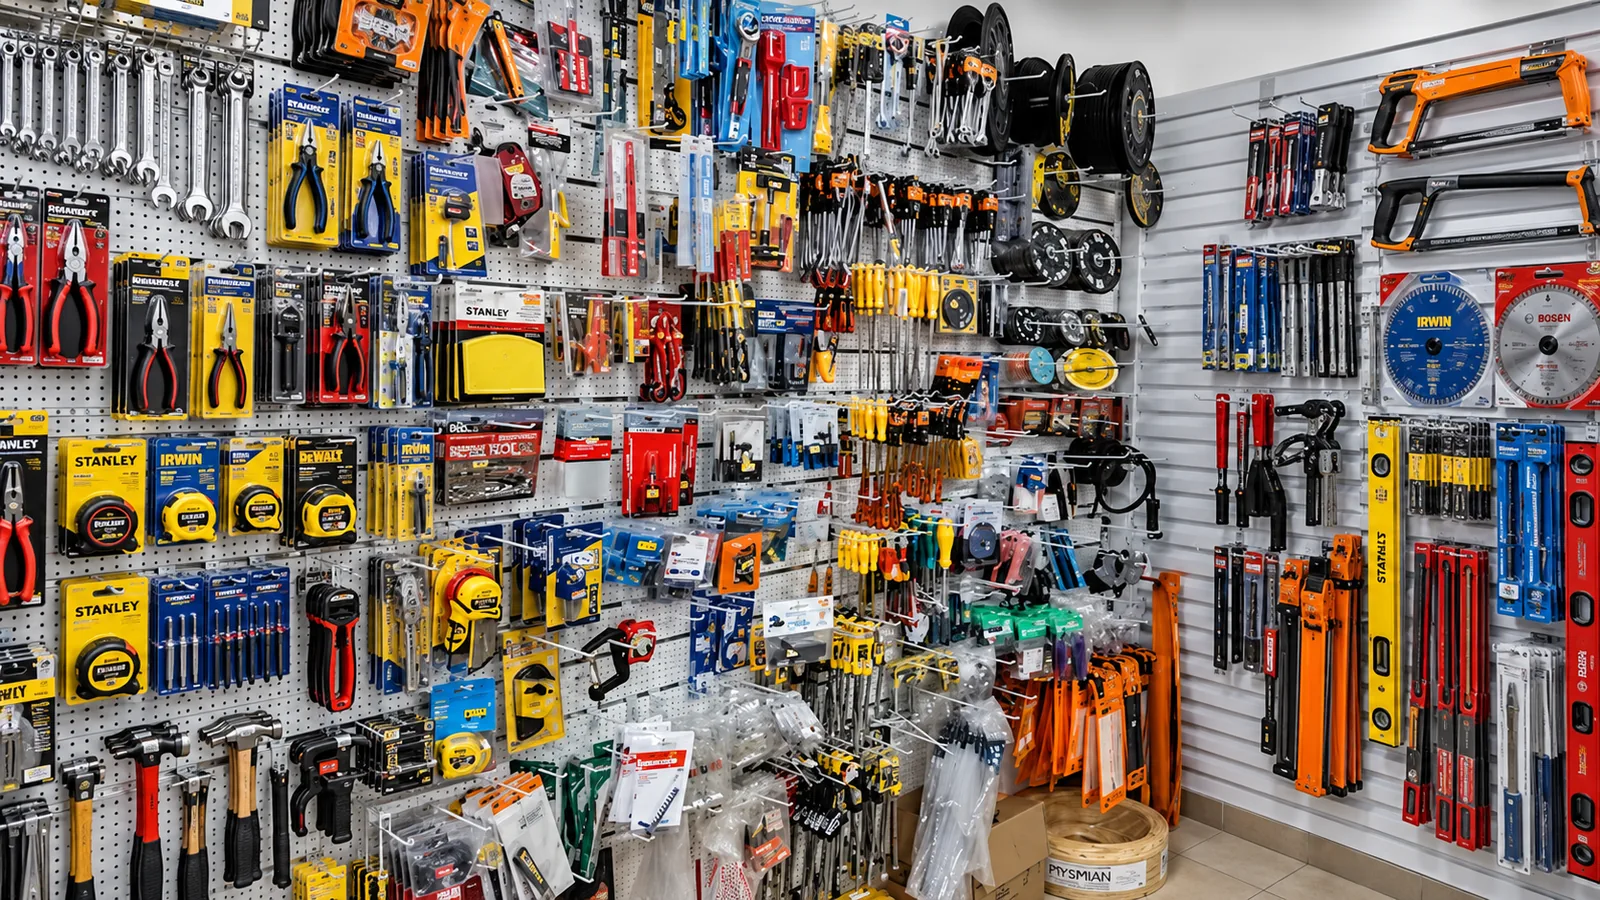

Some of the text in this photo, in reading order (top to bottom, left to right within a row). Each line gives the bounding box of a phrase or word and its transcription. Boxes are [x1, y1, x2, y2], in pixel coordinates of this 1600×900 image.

[466, 306, 510, 318] STANLEY
[1417, 315, 1452, 328] IRWIN
[75, 455, 137, 468] STANLEY
[160, 453, 203, 466] IRWIN
[75, 600, 140, 617] STANLEY
